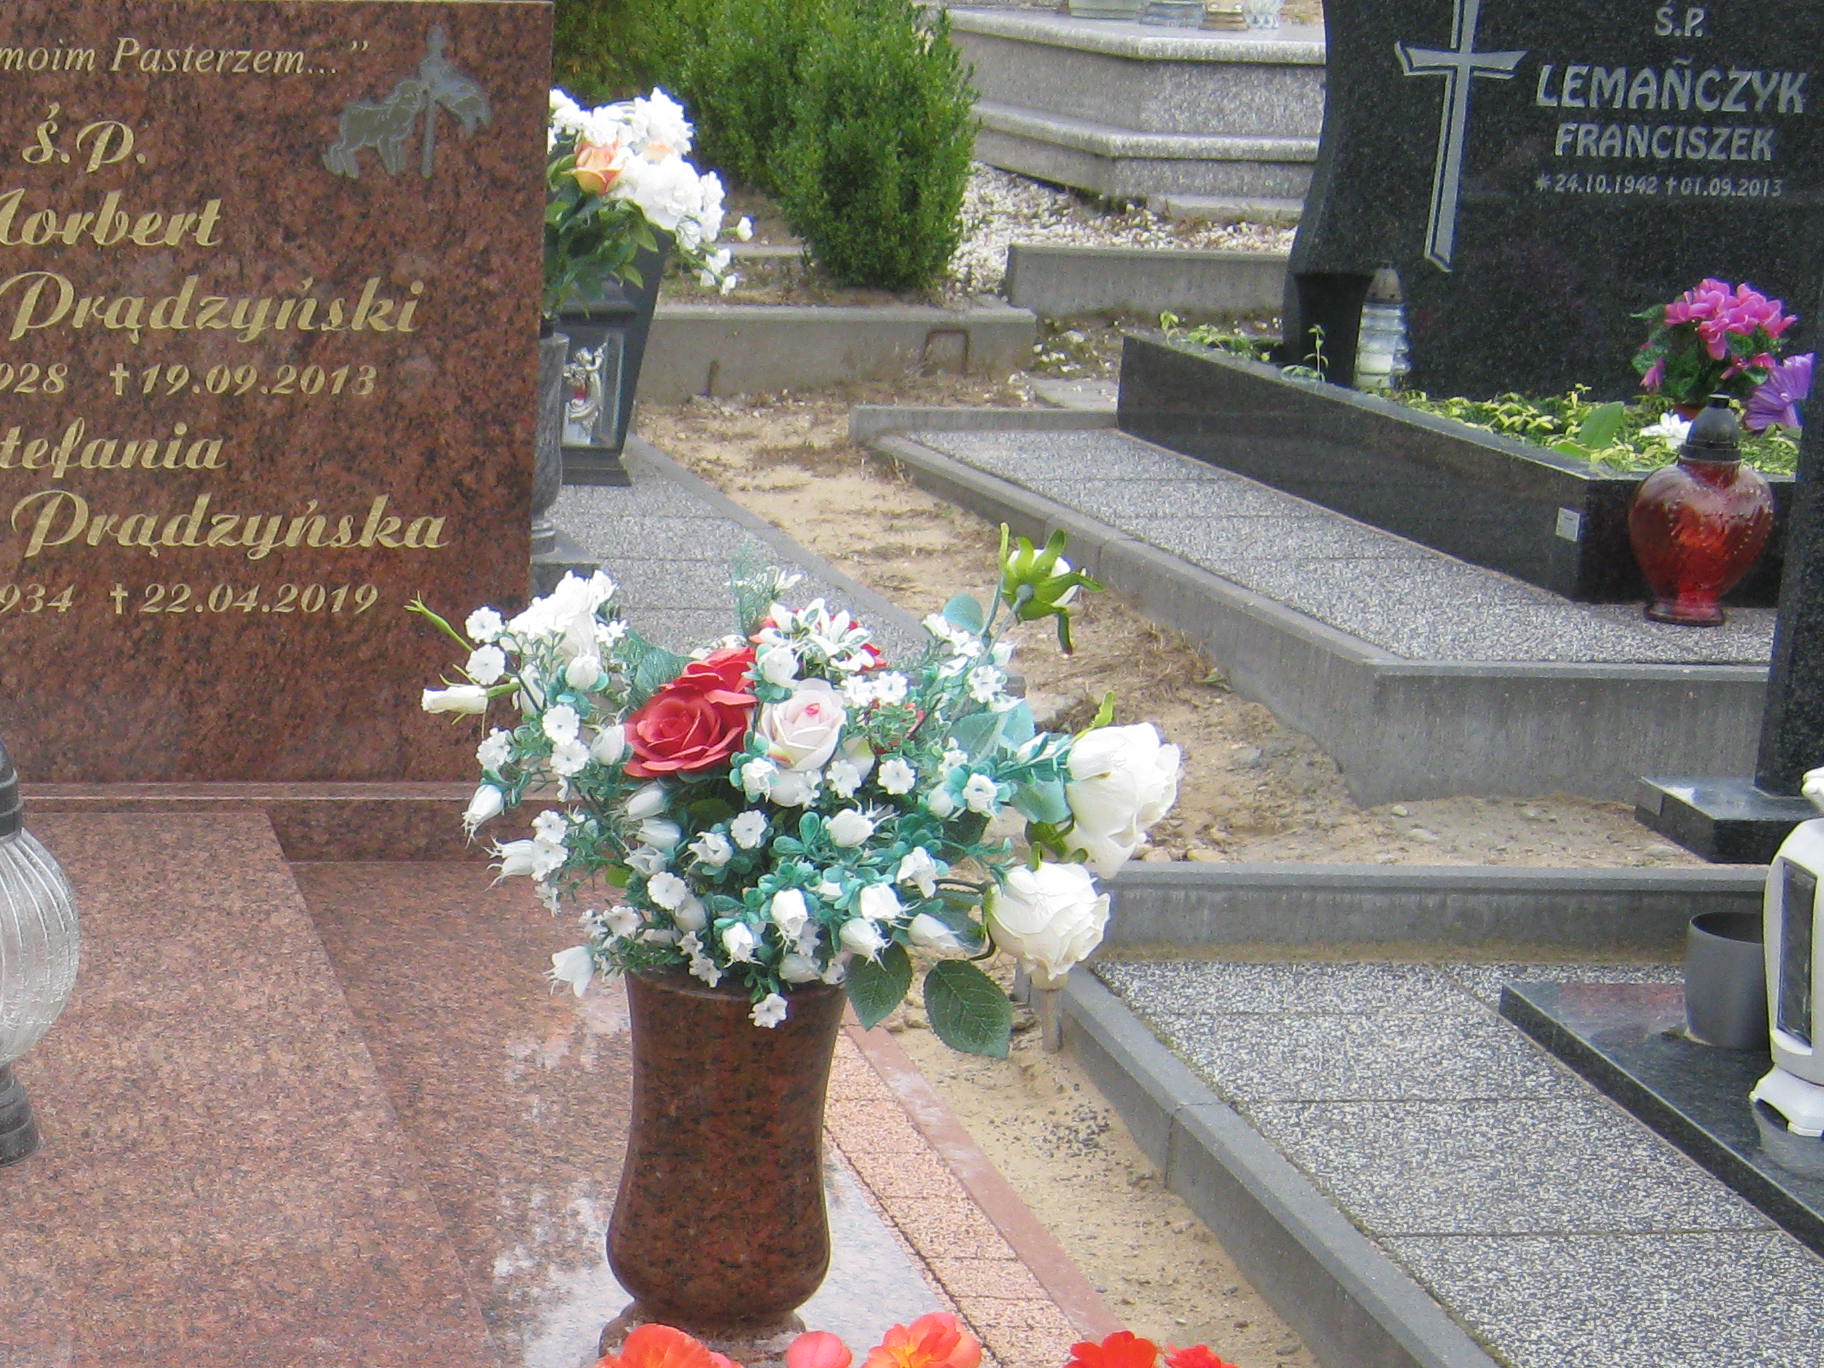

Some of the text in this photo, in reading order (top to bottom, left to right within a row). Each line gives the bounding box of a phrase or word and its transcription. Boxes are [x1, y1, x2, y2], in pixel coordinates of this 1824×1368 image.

[1554, 122, 1776, 161] FRANCISZEK
[1680, 176, 1784, 198] 01.09.2013
[141, 363, 378, 397] 19.09.2013
[11, 489, 451, 561] Prądzyńska
[139, 583, 379, 615] 22.04.2019
